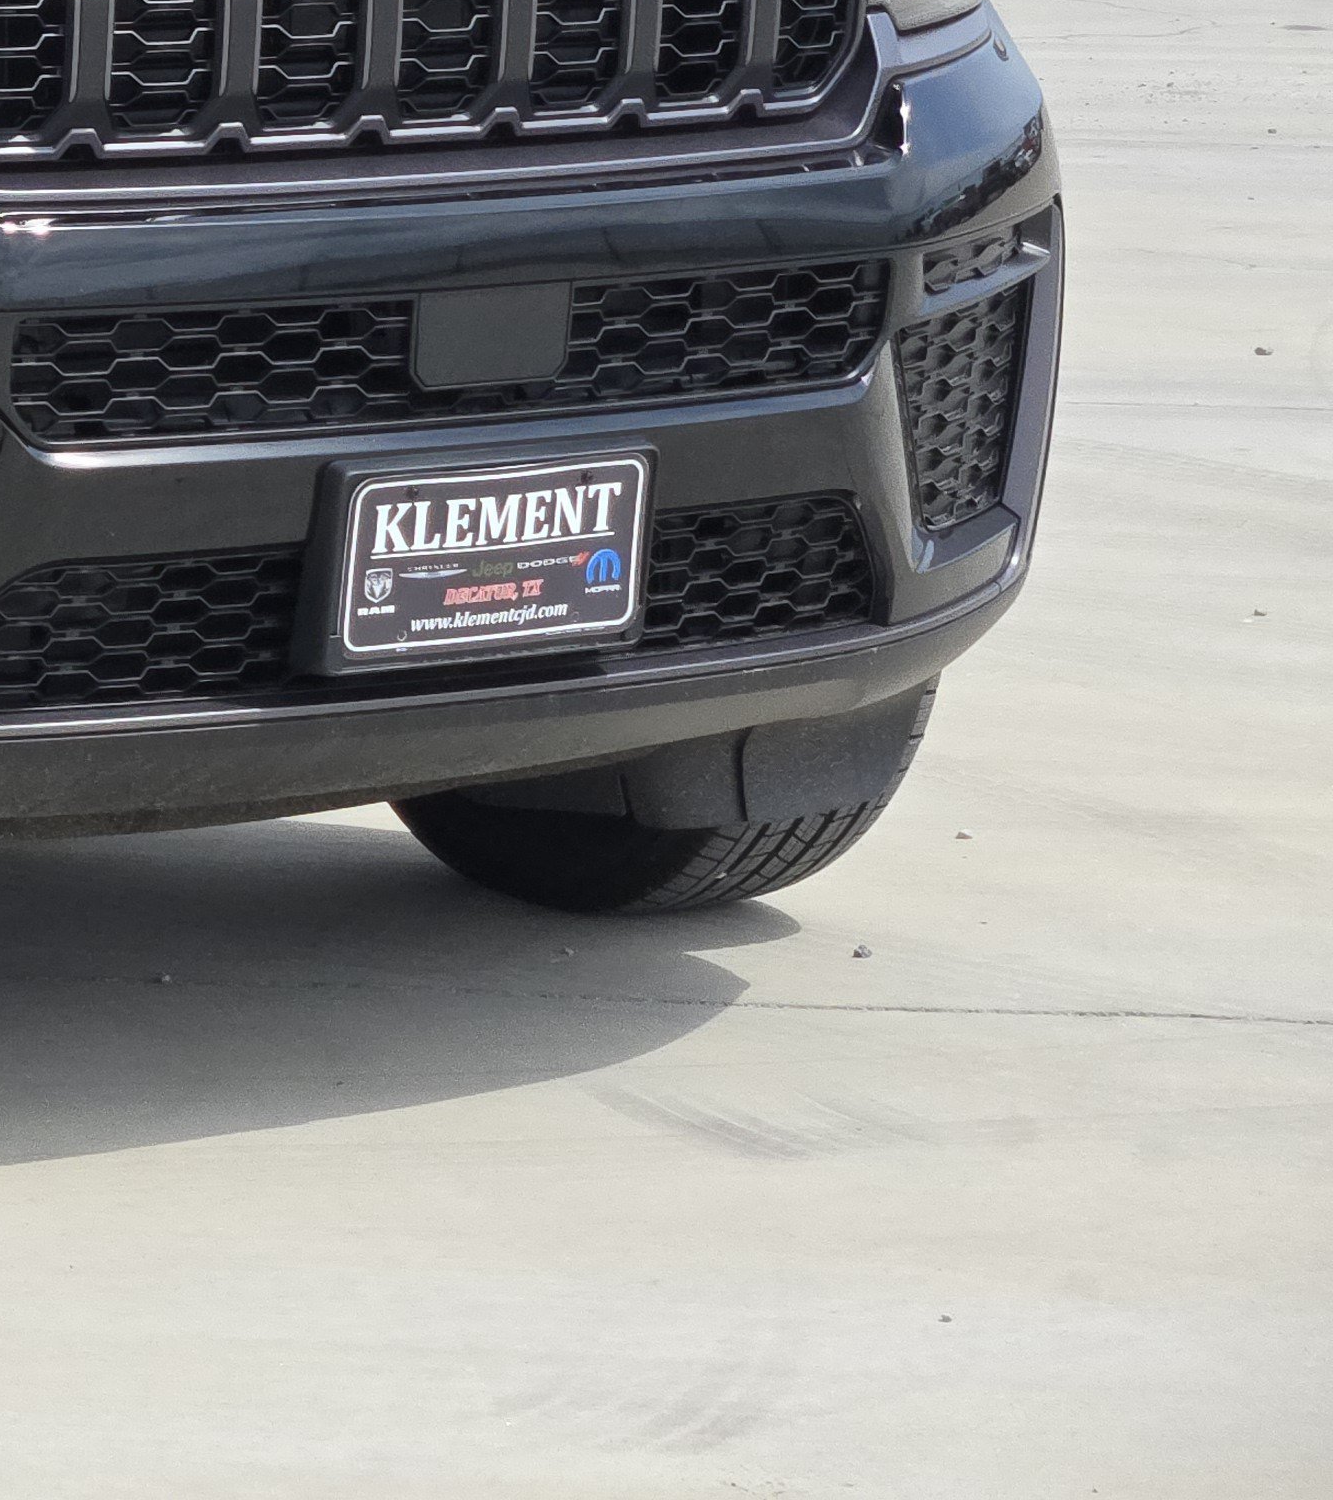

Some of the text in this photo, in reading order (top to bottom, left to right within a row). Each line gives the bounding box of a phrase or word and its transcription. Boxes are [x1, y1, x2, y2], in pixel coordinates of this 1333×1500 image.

[370, 481, 623, 554] KLEMENT
[472, 559, 515, 578] Jeep
[517, 554, 580, 570] DODGE
[522, 578, 545, 598] TX
[357, 604, 396, 617] RAM
[410, 602, 569, 632] www.klementcjd.com
